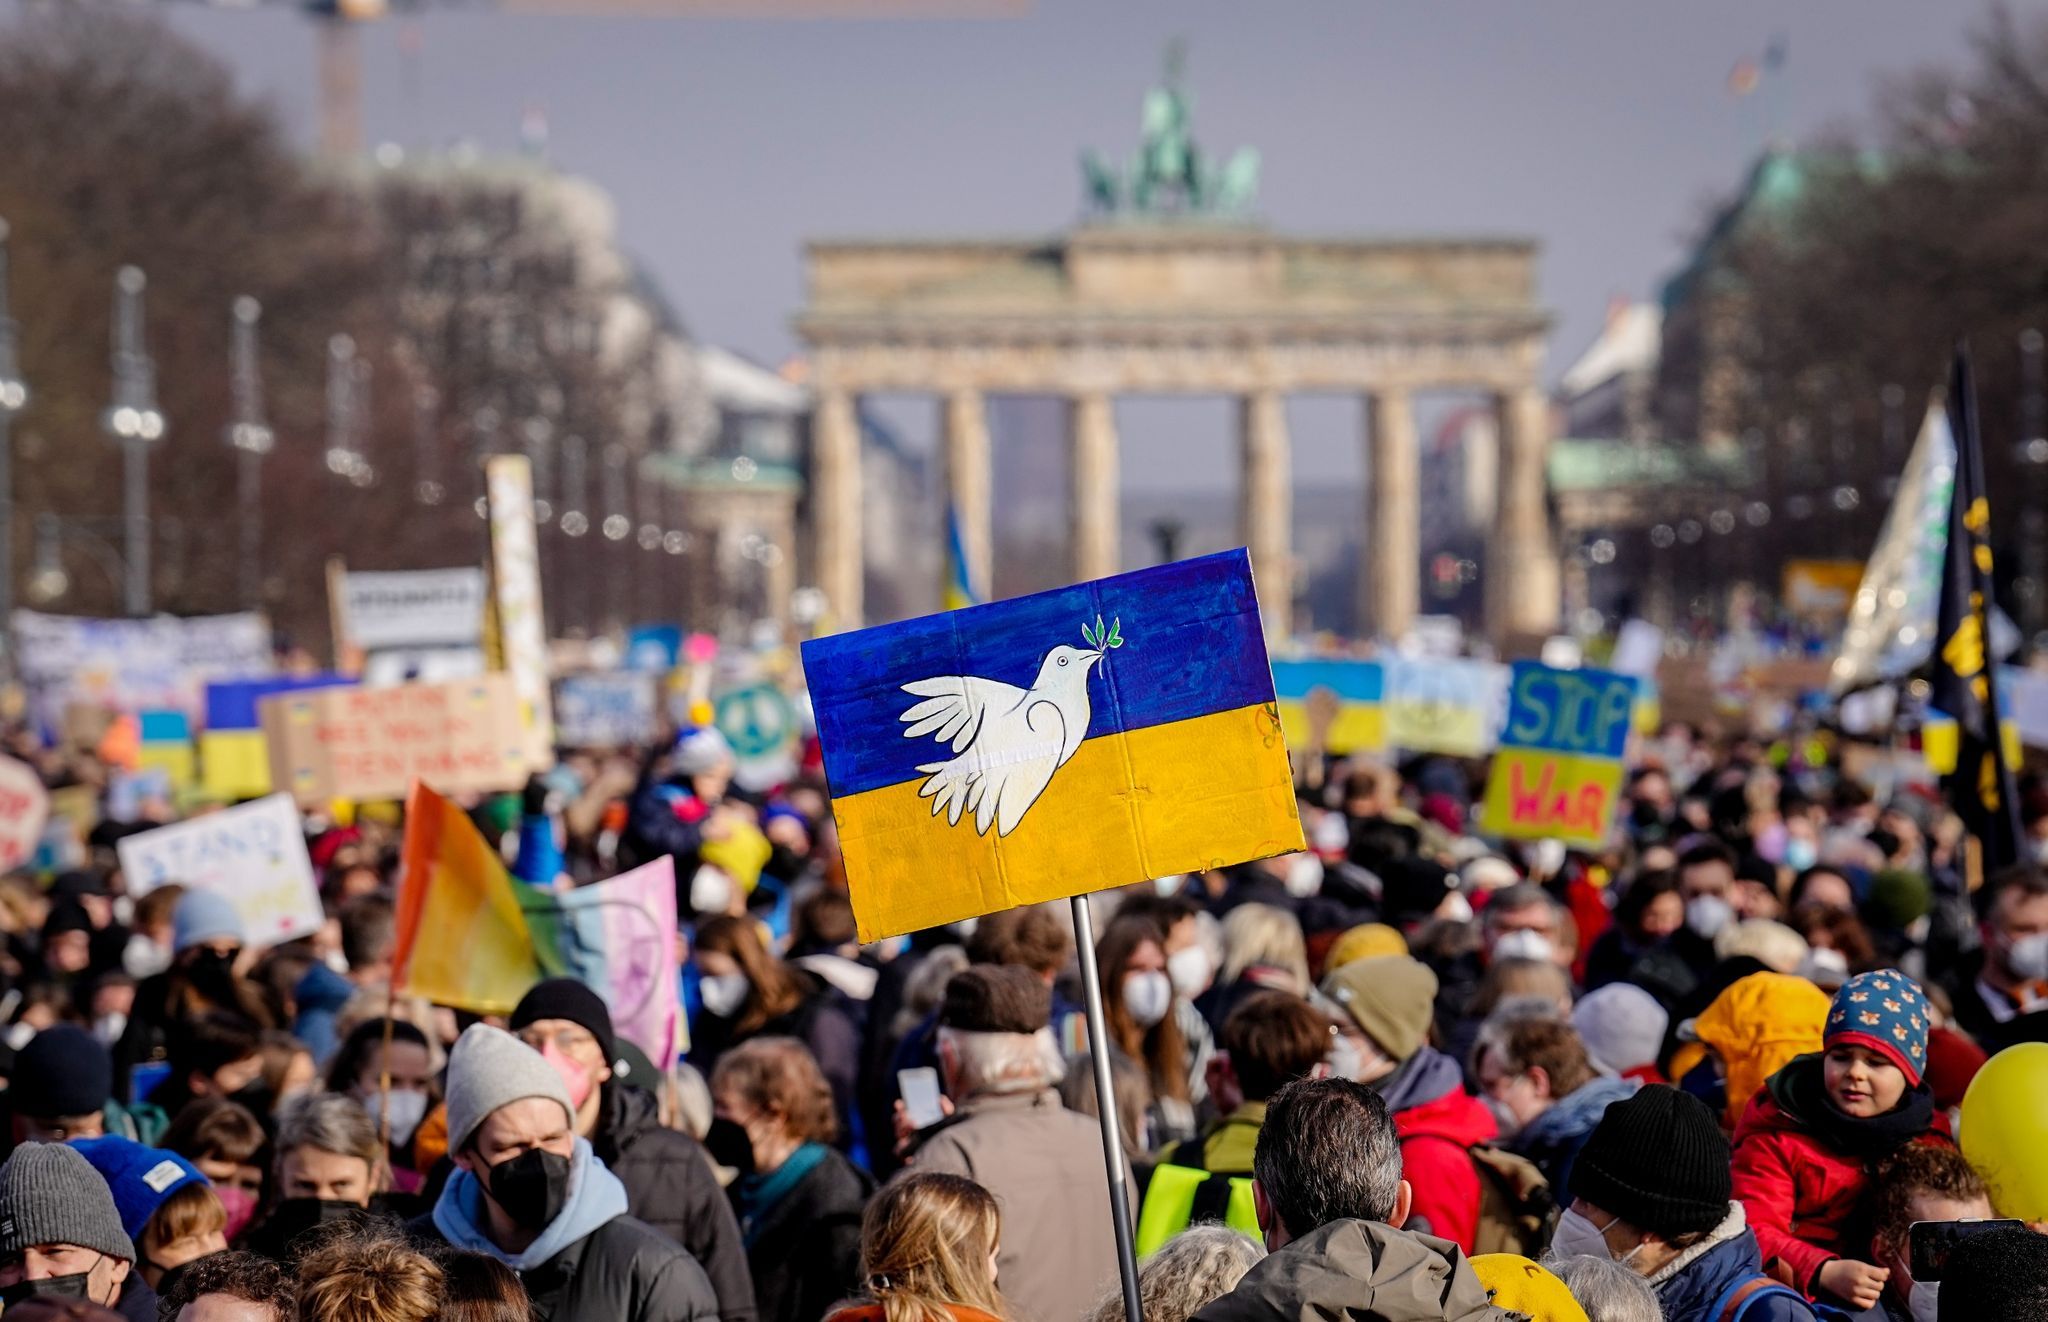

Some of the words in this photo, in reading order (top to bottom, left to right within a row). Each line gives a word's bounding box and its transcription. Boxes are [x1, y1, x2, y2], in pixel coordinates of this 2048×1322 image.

[1511, 670, 1632, 748] STOP
[1508, 758, 1605, 839] WAR
[142, 817, 281, 885] STAND
